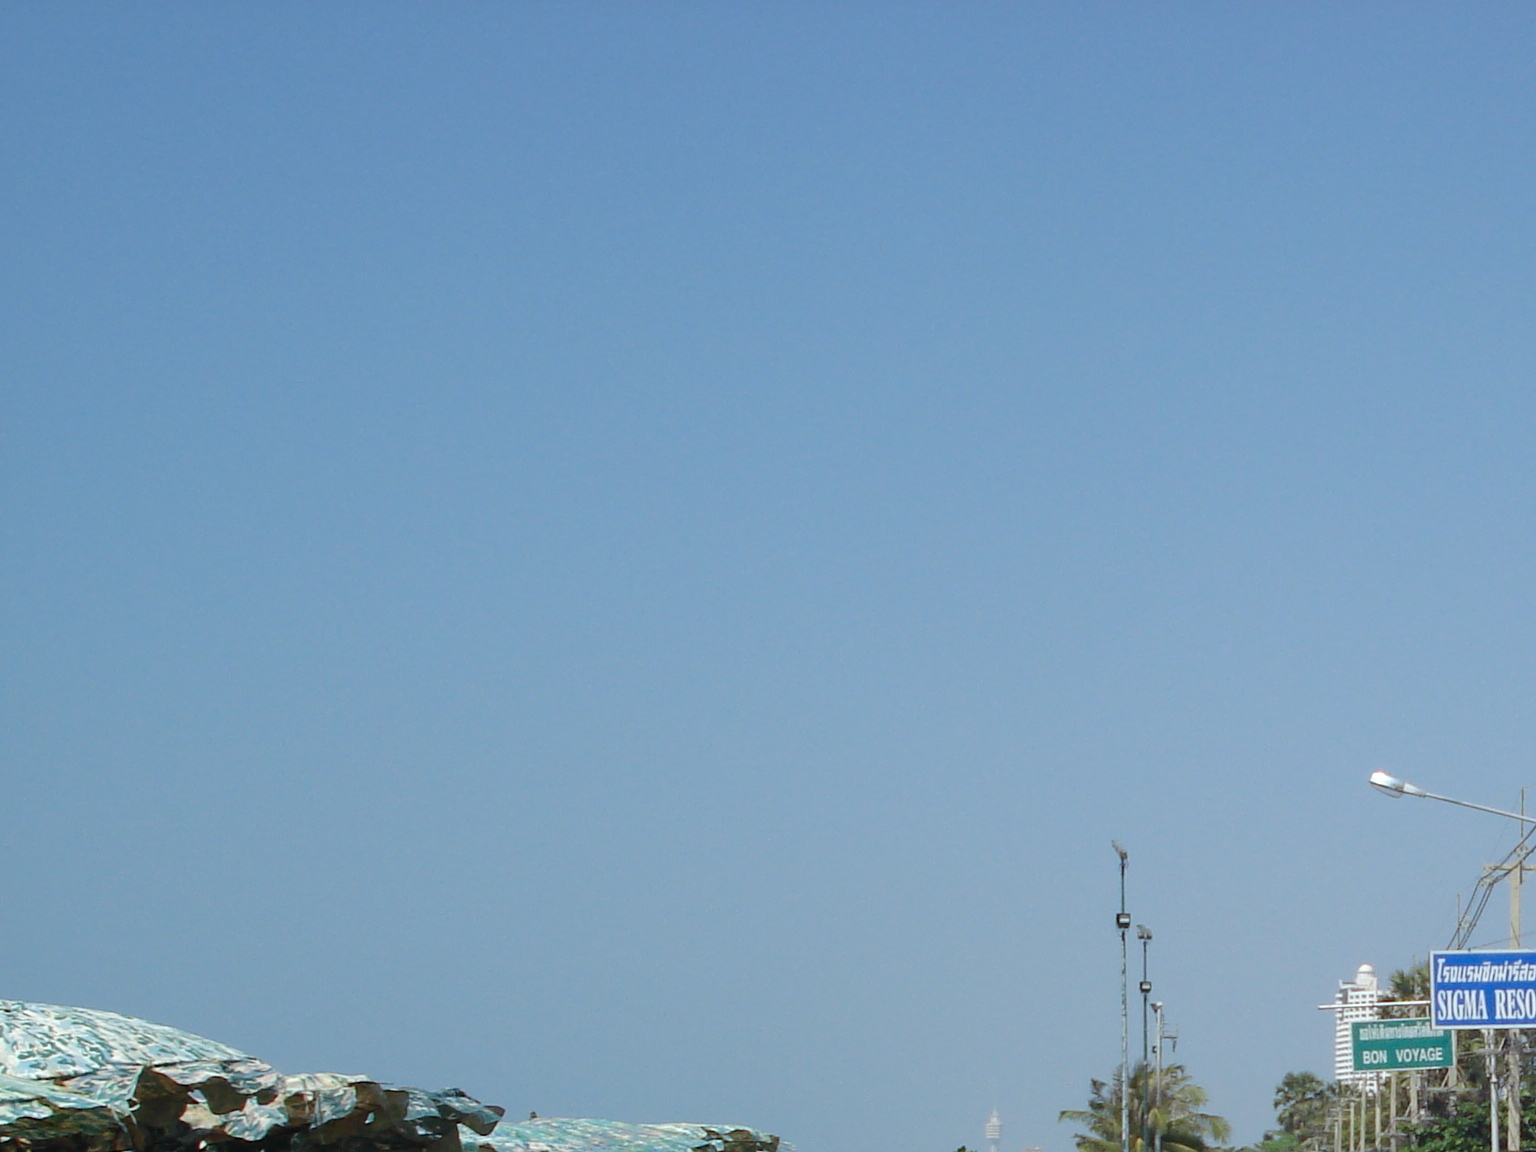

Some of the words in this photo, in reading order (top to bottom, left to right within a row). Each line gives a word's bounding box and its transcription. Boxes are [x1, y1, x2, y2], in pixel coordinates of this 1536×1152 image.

[1437, 989, 1488, 1020] SIGMA
[1363, 1051, 1387, 1065] BON
[1395, 1048, 1443, 1063] VOYAGE
